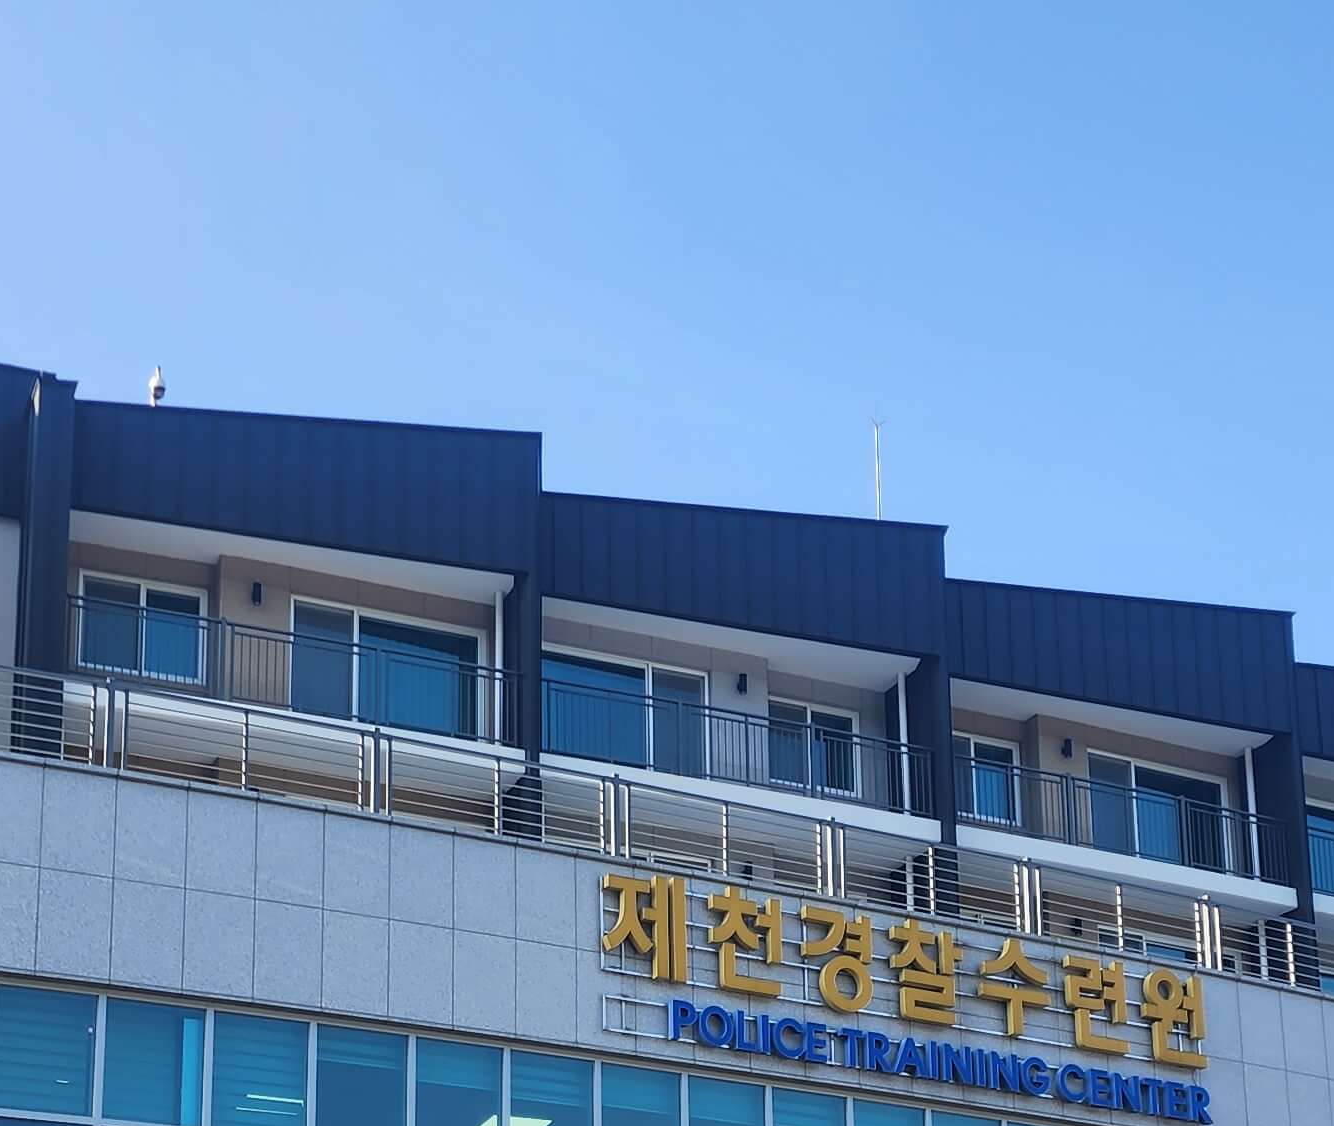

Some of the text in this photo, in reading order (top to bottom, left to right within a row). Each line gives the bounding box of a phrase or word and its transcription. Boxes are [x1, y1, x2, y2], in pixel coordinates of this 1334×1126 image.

[600, 873, 1208, 1069] 제천경찰수련원
[667, 999, 1214, 1125] POLICE TRAINING CENTER
